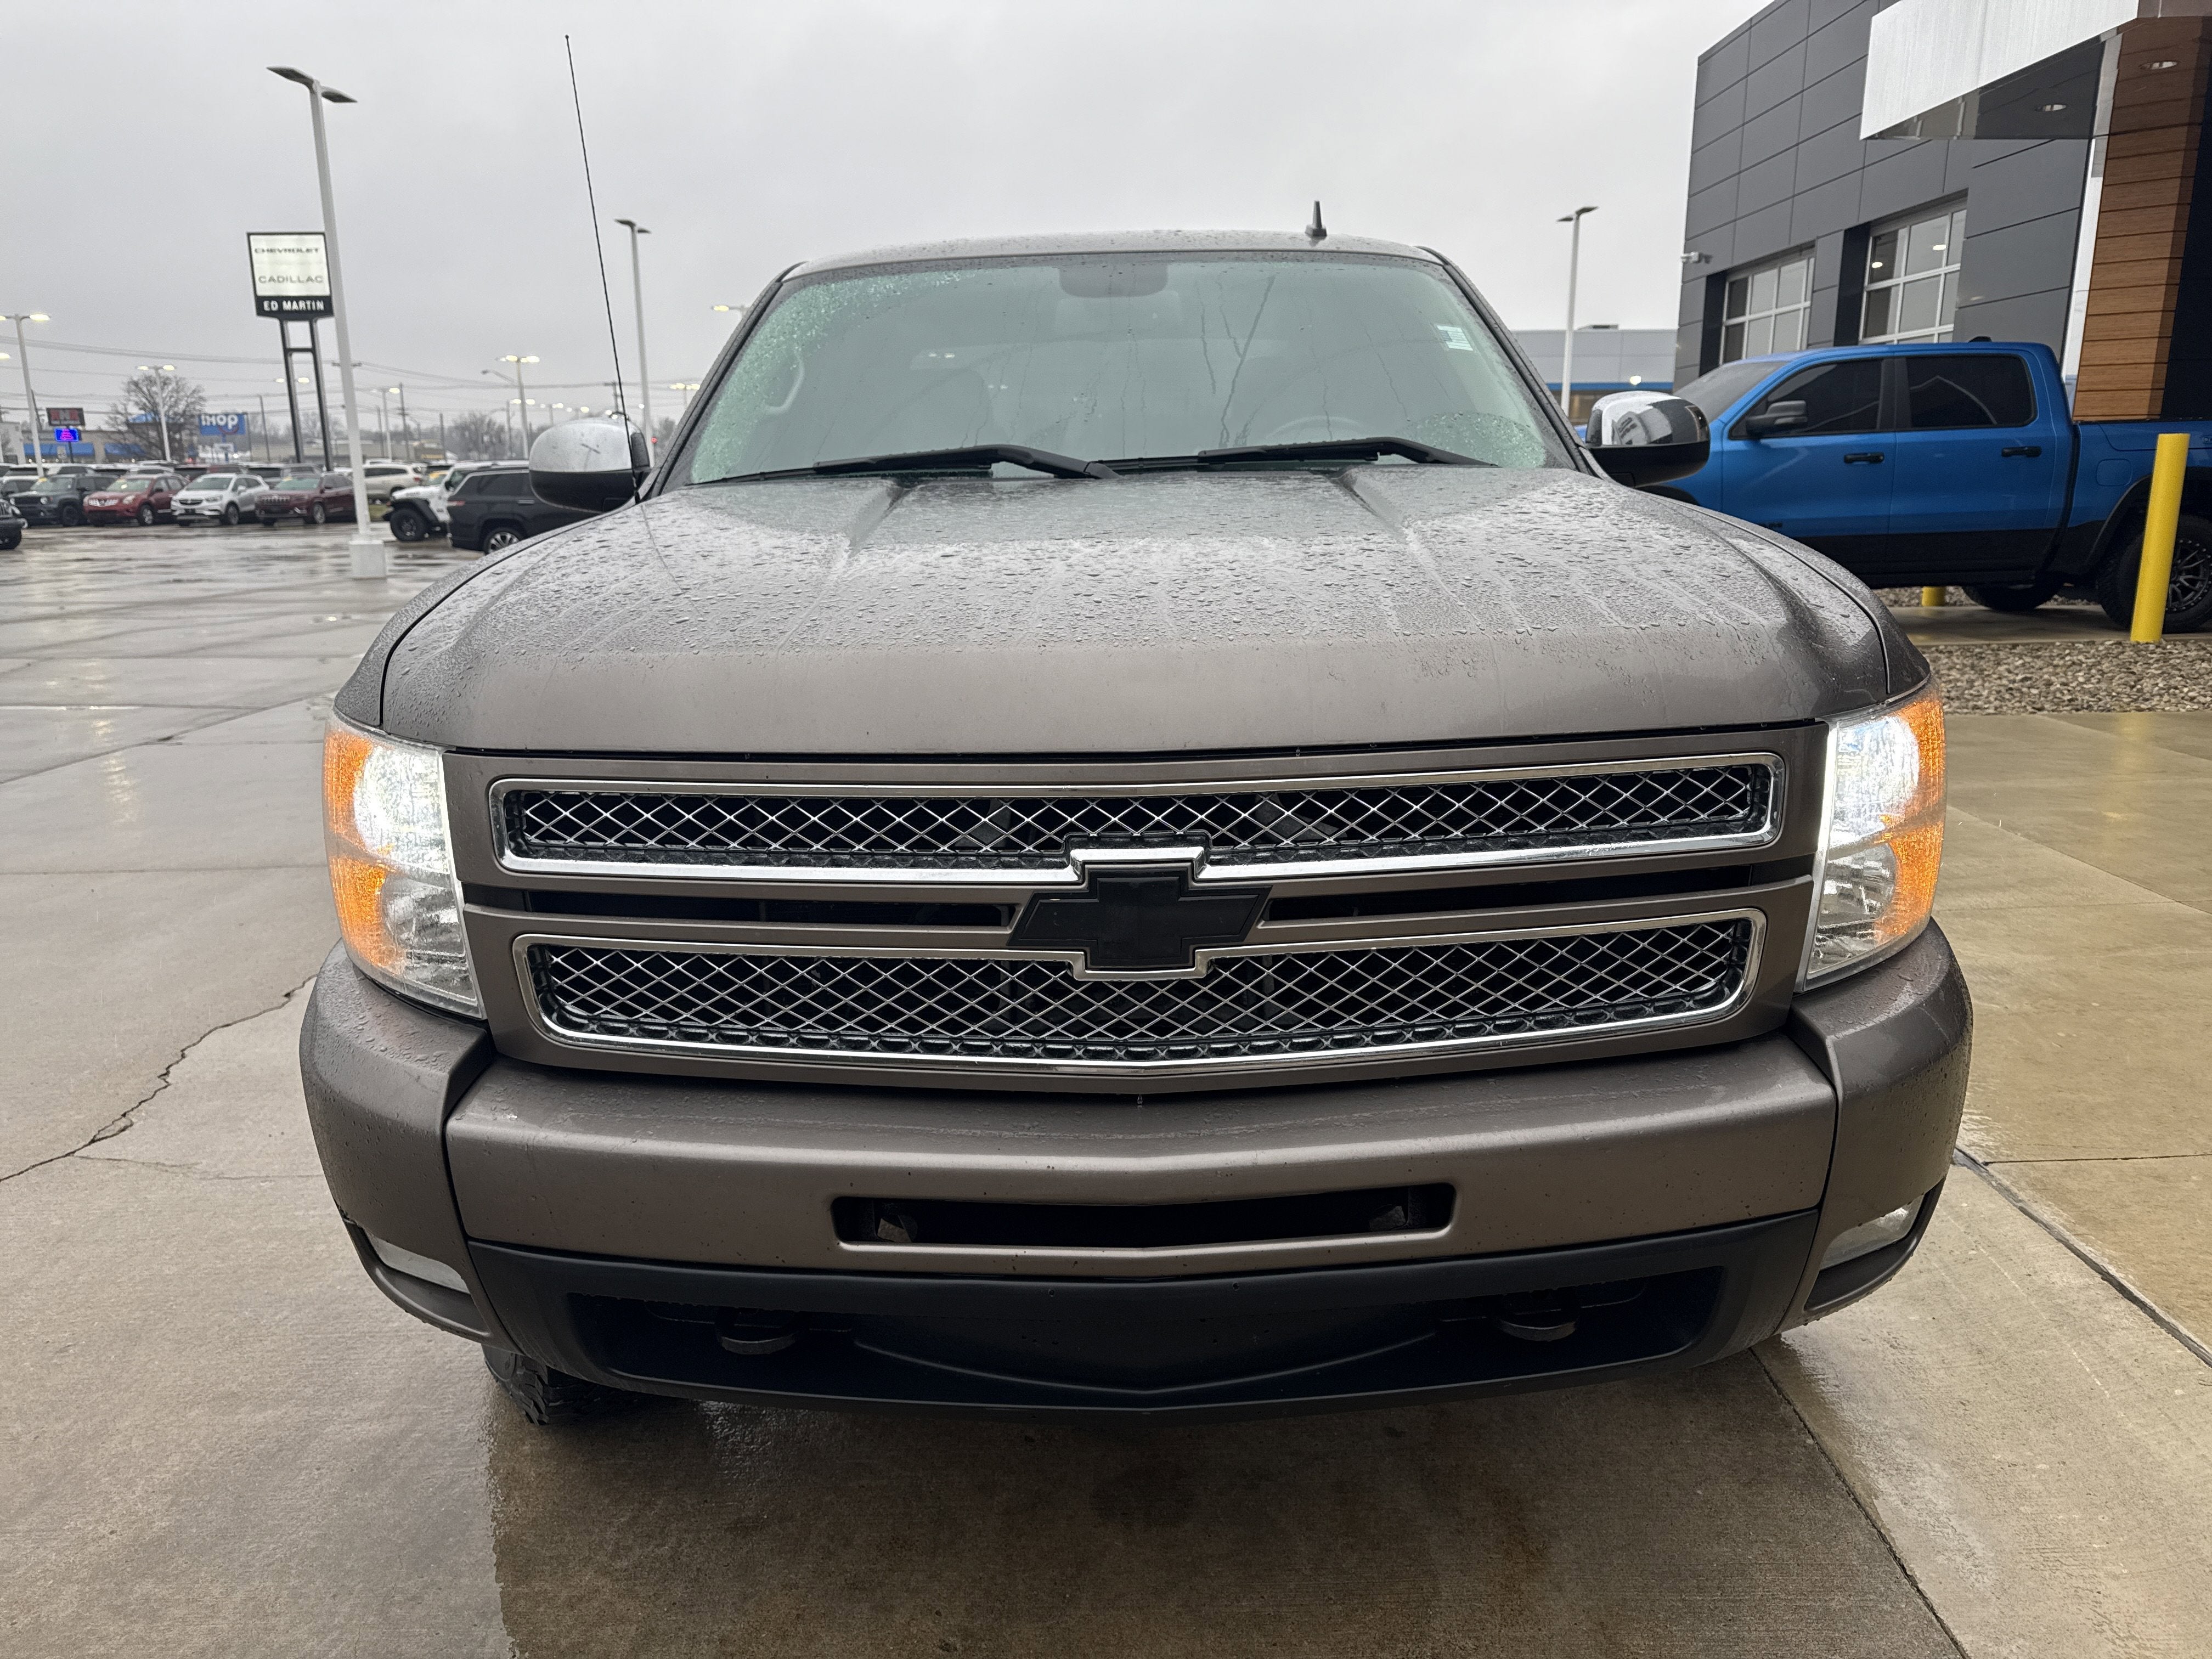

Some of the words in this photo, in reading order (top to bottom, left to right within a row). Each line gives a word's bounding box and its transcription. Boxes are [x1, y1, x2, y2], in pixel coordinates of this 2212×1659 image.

[258, 275, 324, 284] CADILLAC
[263, 300, 279, 311] ED
[282, 300, 325, 311] MARTIN
